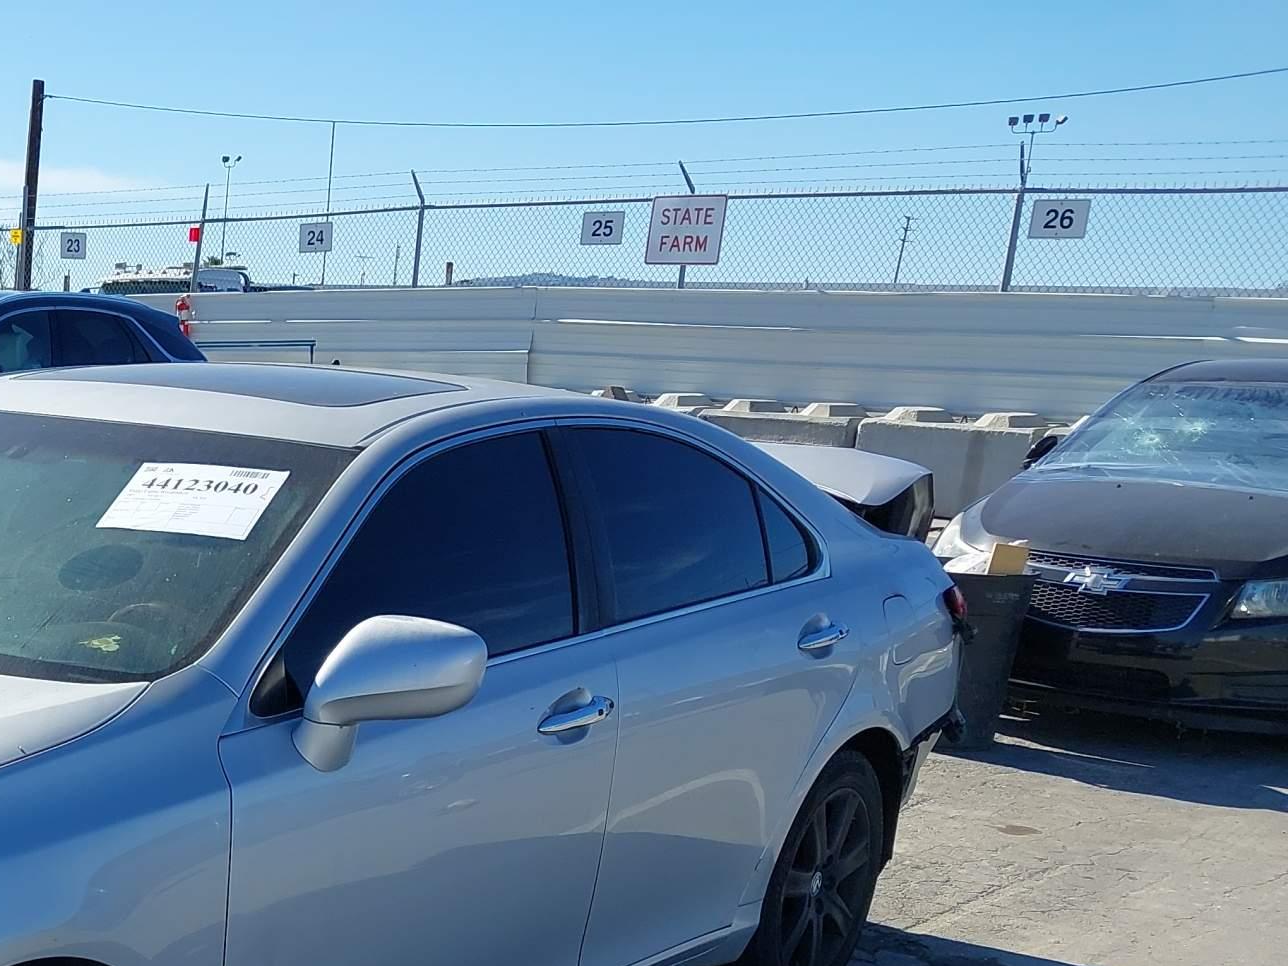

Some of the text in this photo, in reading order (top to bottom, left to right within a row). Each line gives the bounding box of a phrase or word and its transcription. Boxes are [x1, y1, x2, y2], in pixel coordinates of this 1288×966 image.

[660, 207, 715, 226] STATE
[1043, 208, 1075, 229] 26
[592, 219, 614, 237] 25
[66, 239, 80, 253] 23
[307, 230, 324, 246] 24
[658, 234, 709, 253] FARM
[141, 474, 259, 496] 44123040
